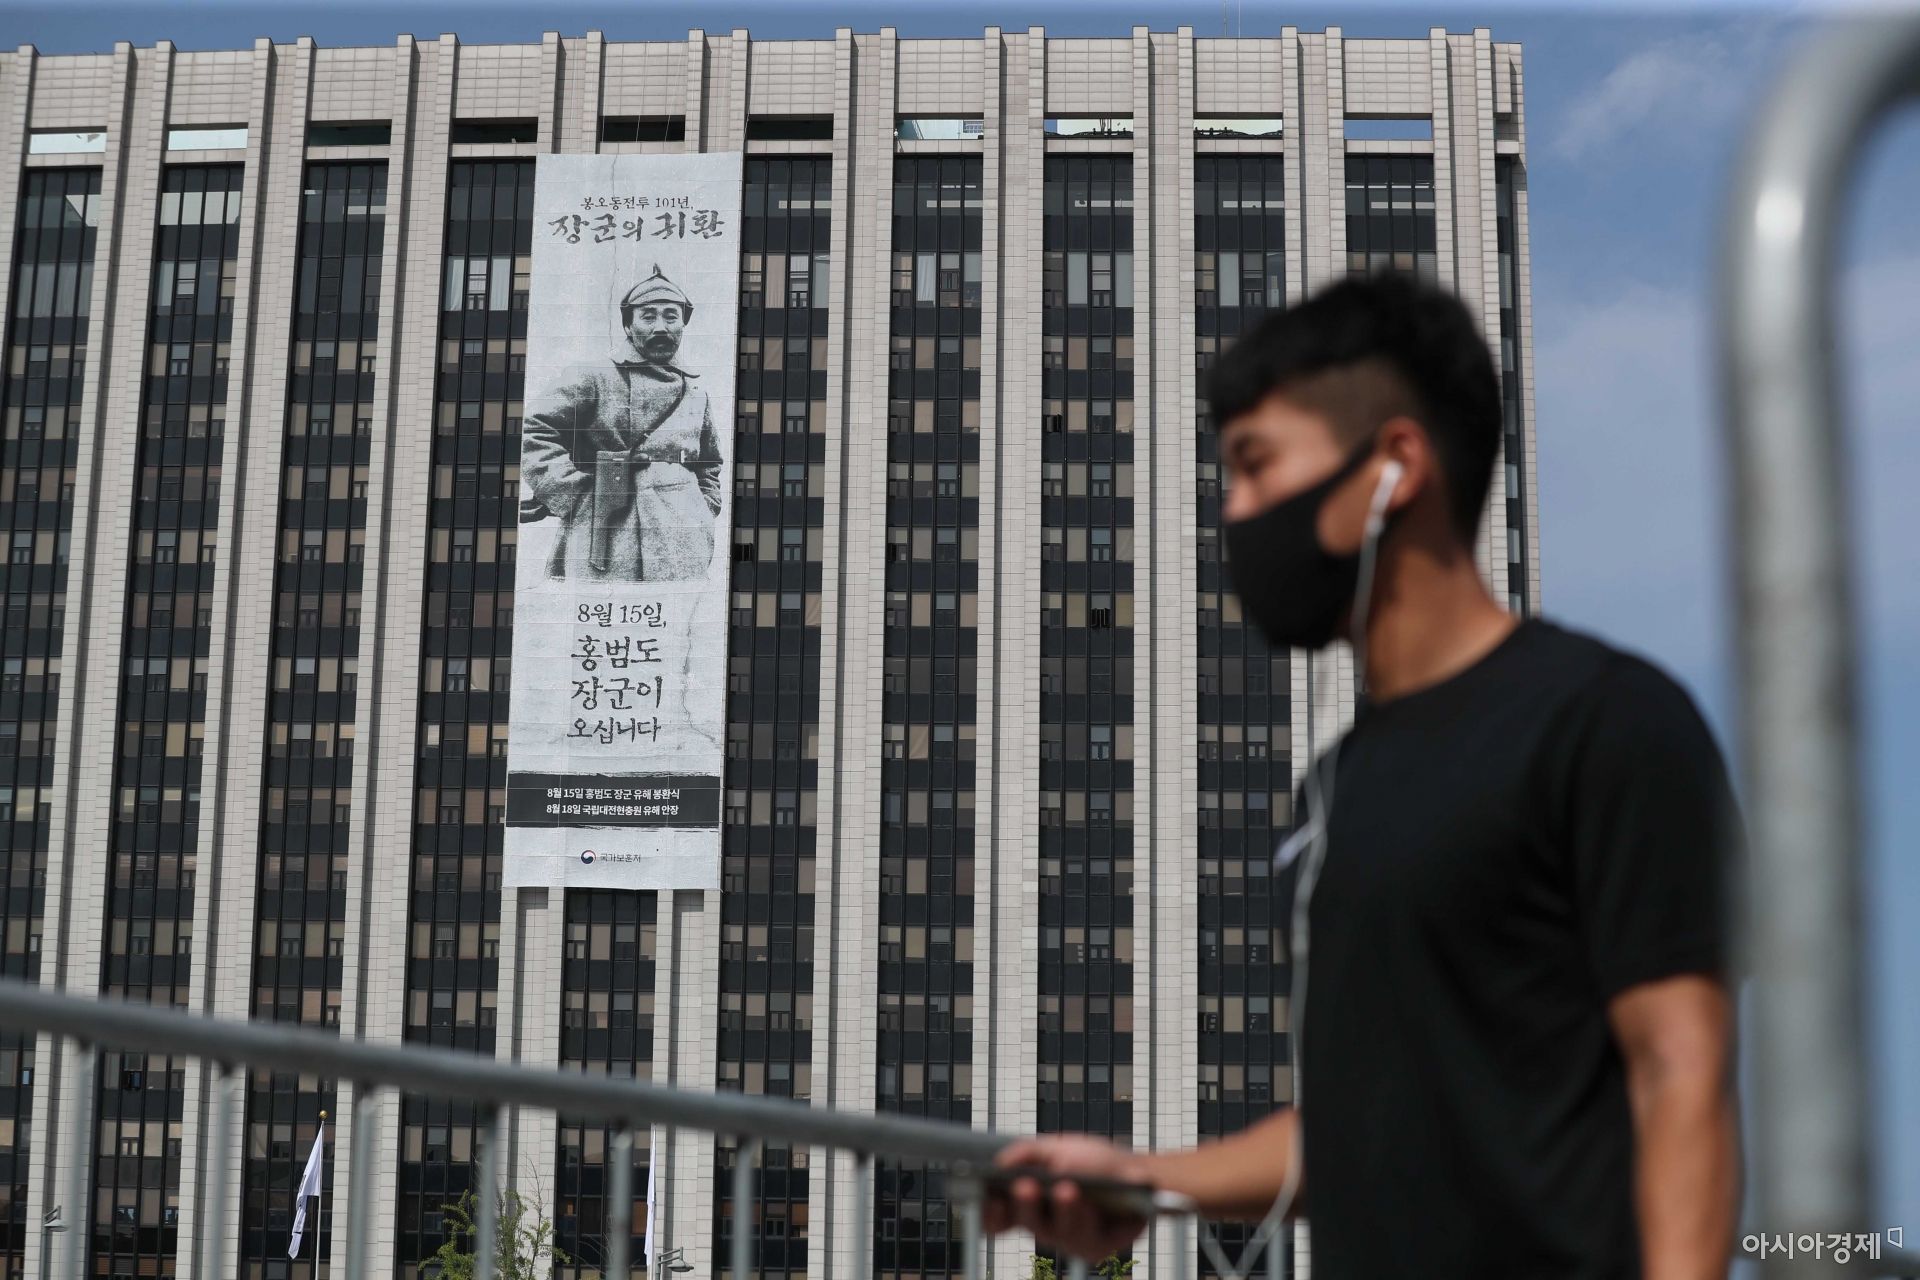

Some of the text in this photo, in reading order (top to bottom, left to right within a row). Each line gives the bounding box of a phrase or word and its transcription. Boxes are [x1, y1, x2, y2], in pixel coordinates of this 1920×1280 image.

[580, 196, 694, 211] 봉오동전투 101년,
[548, 209, 725, 244] 장군의 귀환
[577, 602, 667, 628] 8월 15일,
[570, 634, 662, 672] 홍범도
[571, 675, 663, 711] 장군이
[566, 716, 662, 745] 오십니다
[547, 788, 680, 801] 8월 15일 홍범도 장군 유해 봉환식
[546, 803, 679, 816] 8월 18일 국립대전현충원 유해 안장
[600, 853, 641, 863] 국가보훈처
